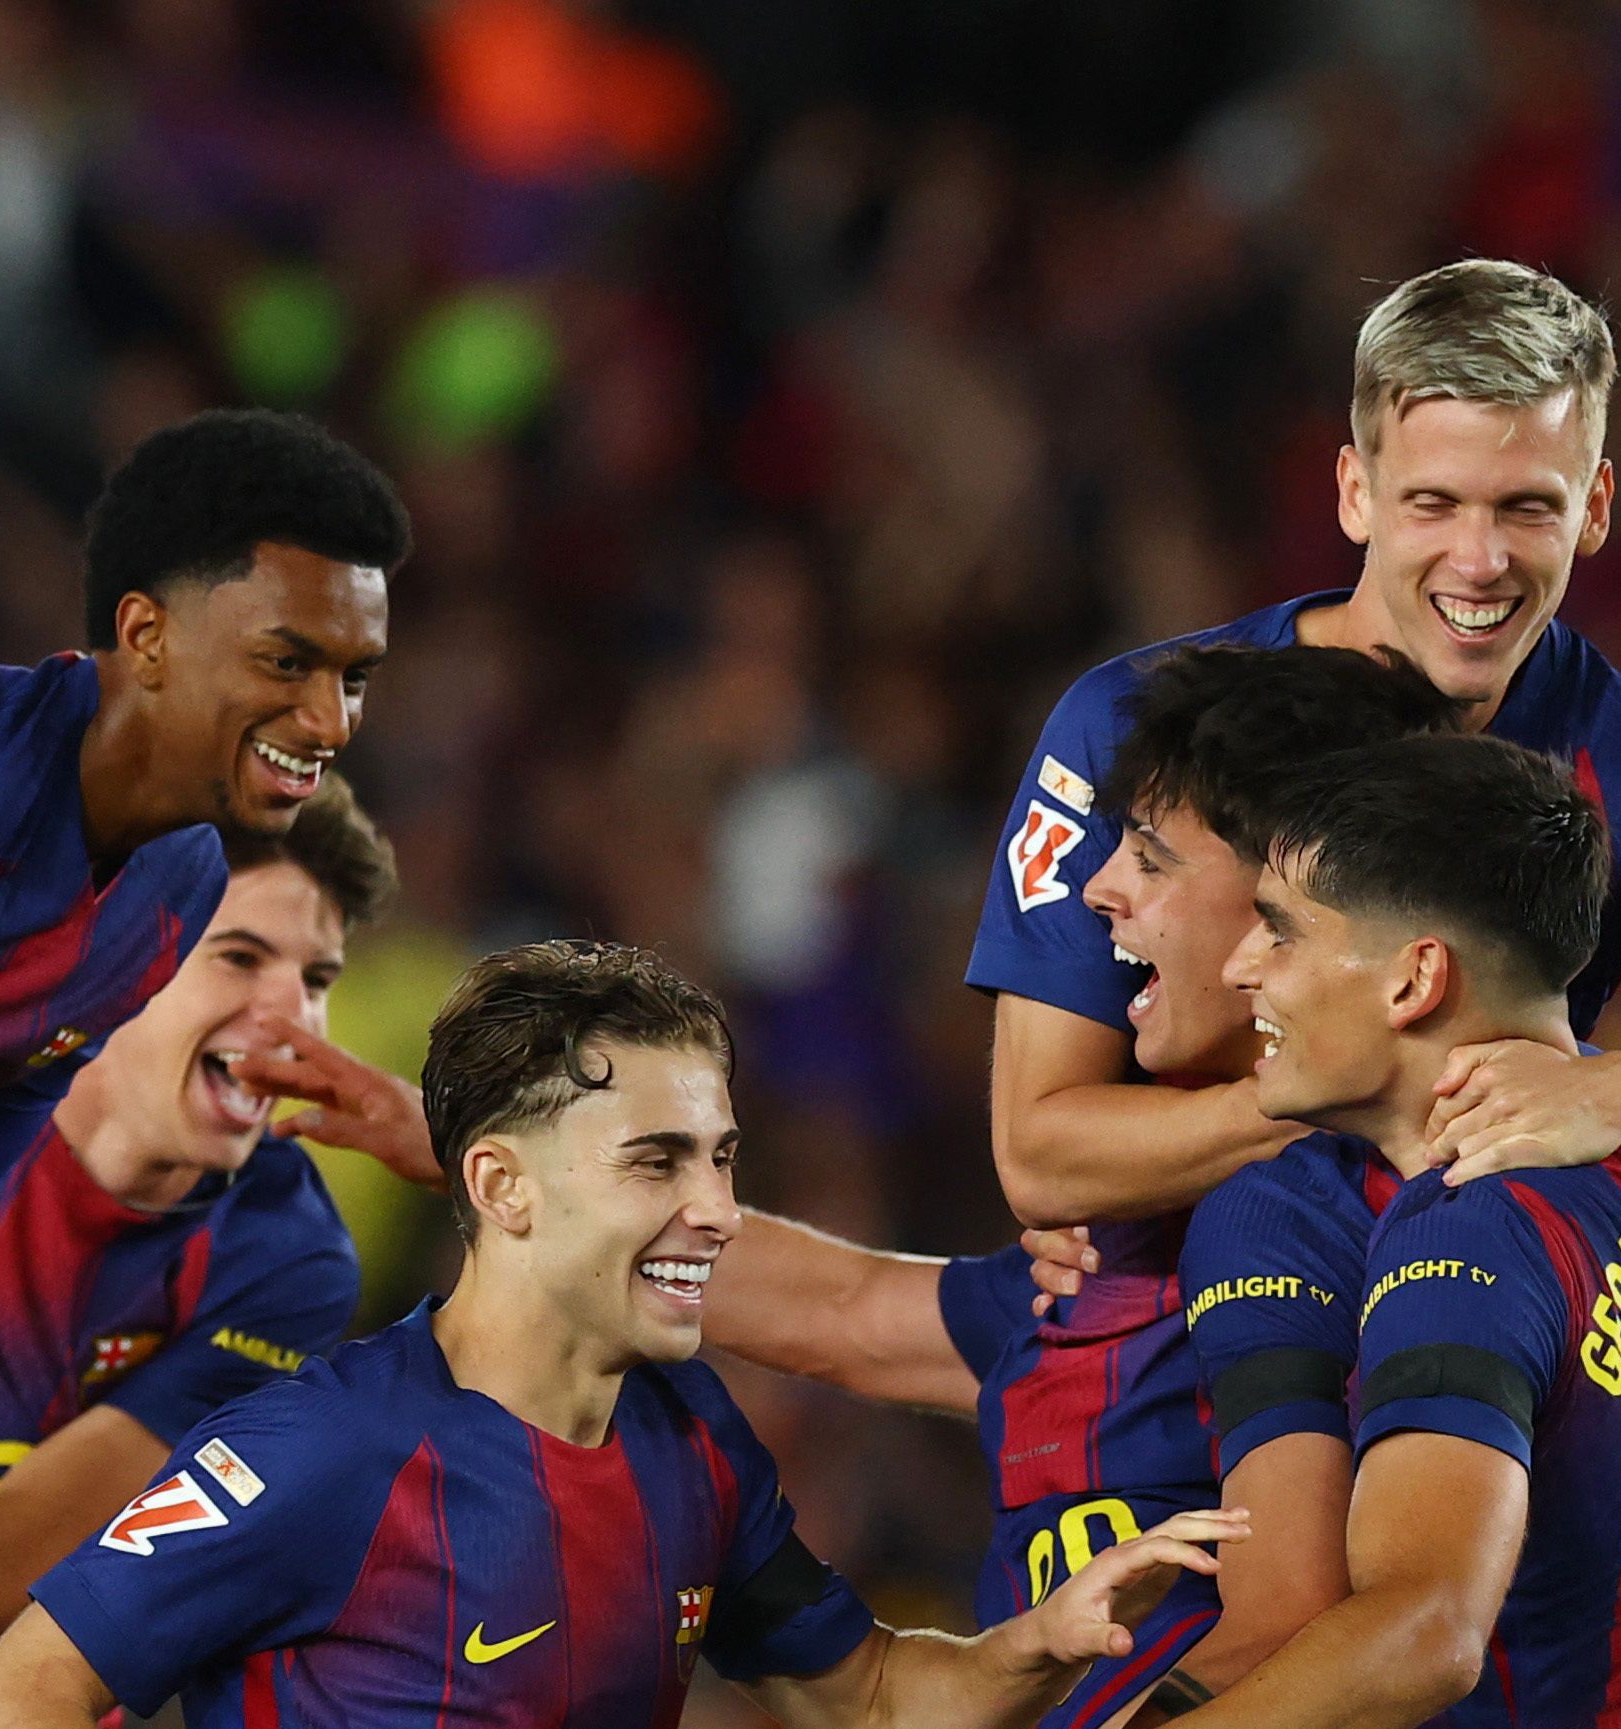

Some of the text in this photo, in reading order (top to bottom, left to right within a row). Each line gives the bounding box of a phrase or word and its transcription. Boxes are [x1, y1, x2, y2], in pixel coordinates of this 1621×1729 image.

[1470, 1266, 1496, 1286] tv
[1185, 1276, 1335, 1332] AMBILIGHT tv
